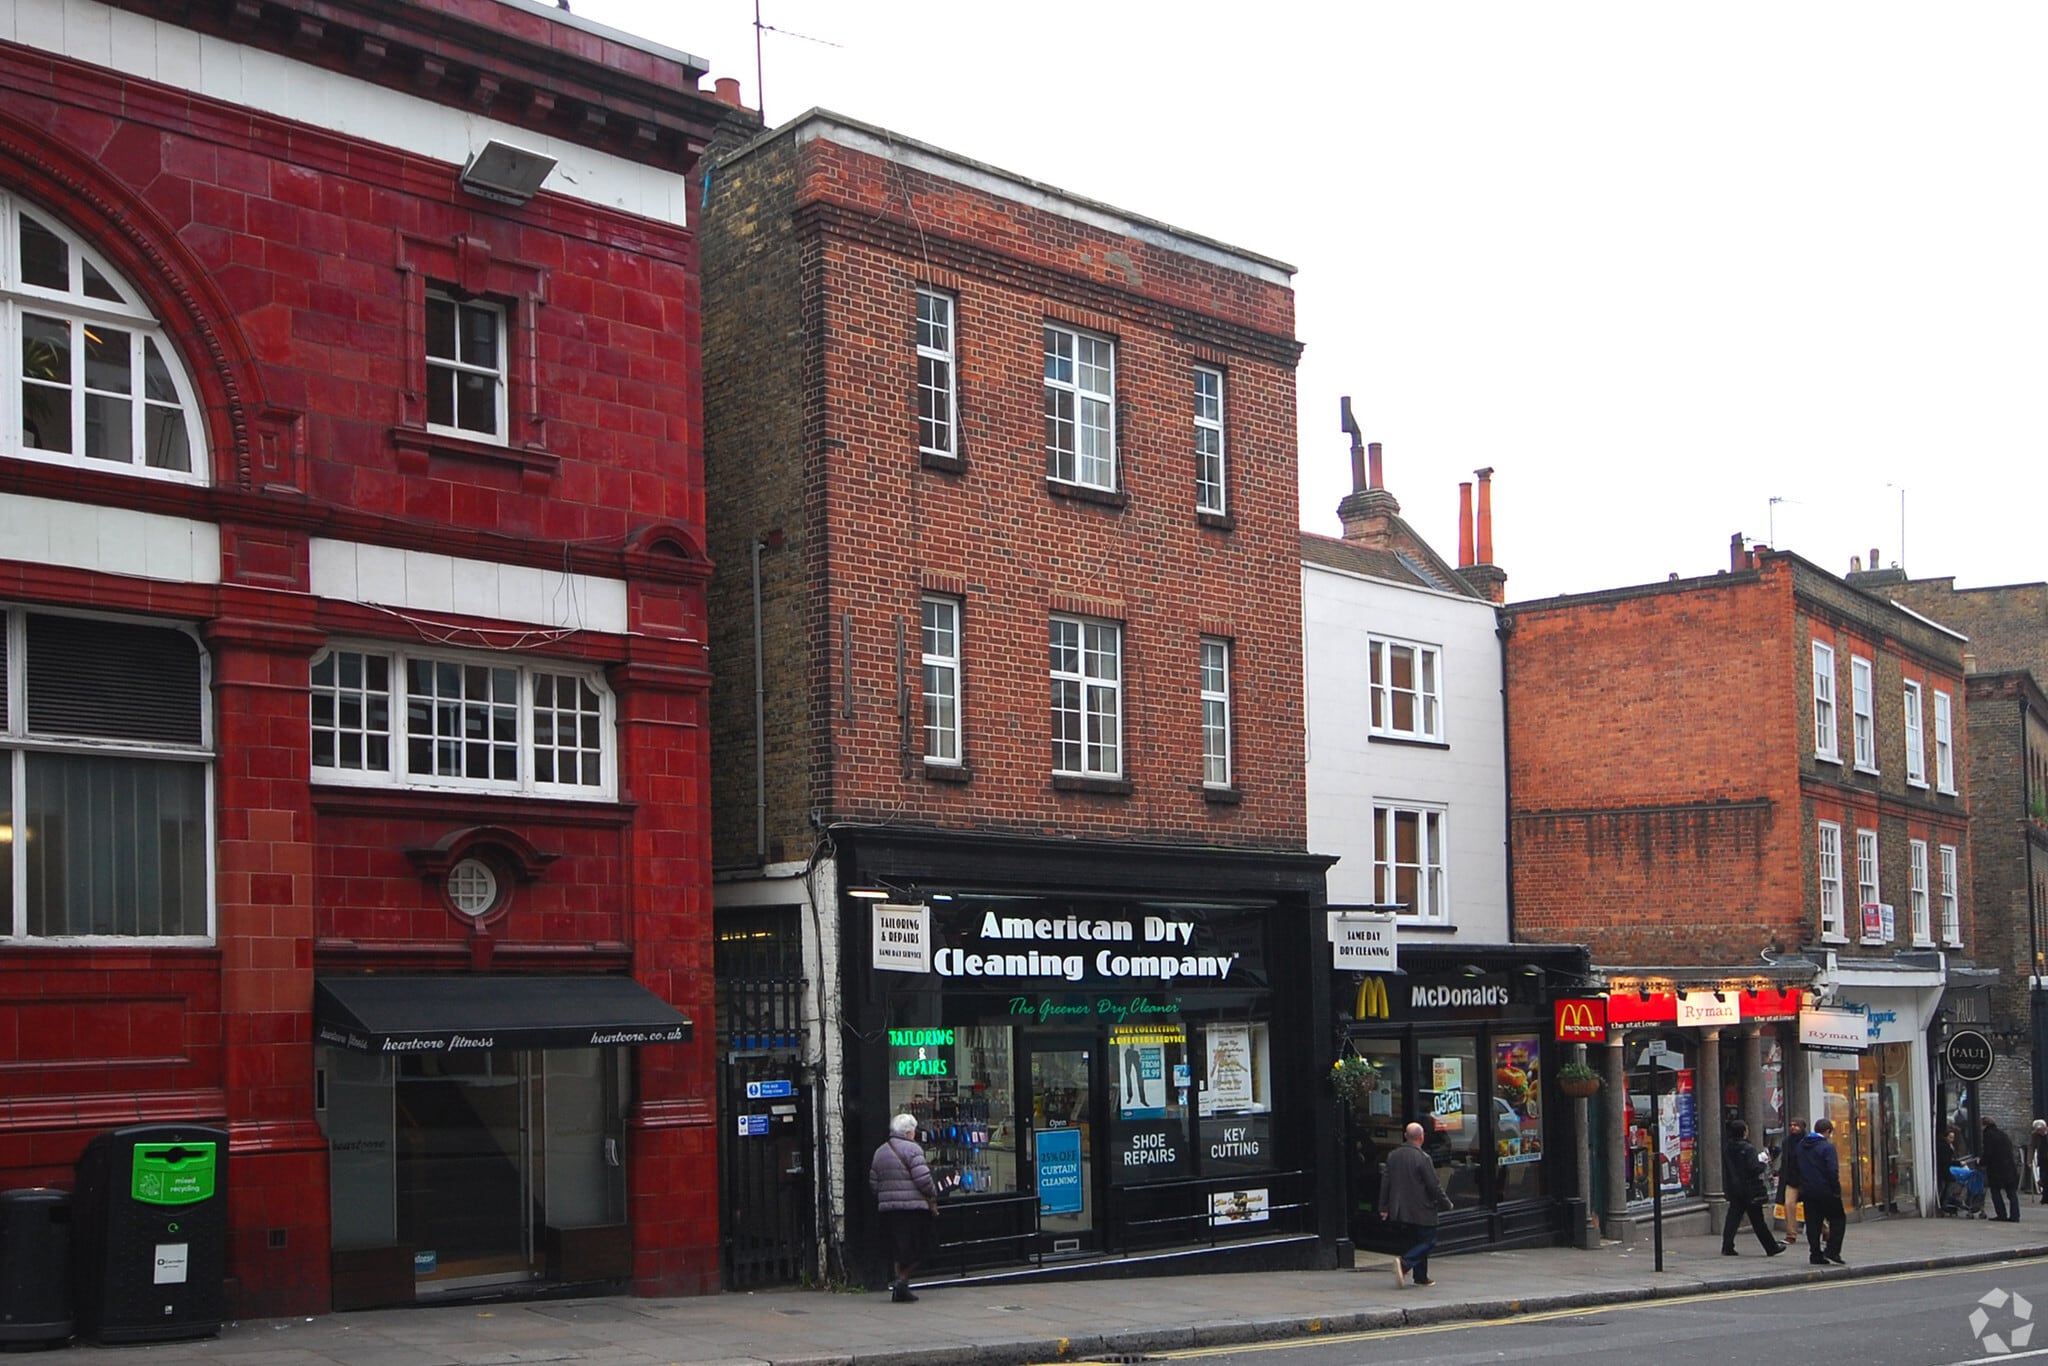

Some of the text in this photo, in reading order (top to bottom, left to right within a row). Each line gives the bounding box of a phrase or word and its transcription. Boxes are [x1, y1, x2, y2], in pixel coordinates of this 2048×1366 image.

[880, 917, 920, 930] TAILORING
[980, 911, 1194, 945] American Dry
[881, 931, 919, 944] & REPAIRS
[1347, 931, 1380, 941] SAME DAY
[1340, 946, 1390, 957] DRY CLEANING
[934, 947, 1084, 981] Cleaning
[1411, 985, 1509, 1007] McDonald's
[1008, 997, 1035, 1015] The
[1039, 998, 1090, 1023] Greener
[1097, 998, 1128, 1024] Dry
[1685, 1005, 1733, 1020] Ryman
[1956, 998, 1977, 1022] PAUL
[1134, 1024, 1181, 1034] COLLECTION
[1611, 1020, 1625, 1029] the
[590, 1027, 682, 1044] heartcore.co.uk
[888, 1029, 954, 1046] TAILORING
[1808, 1030, 1859, 1040] Ryman
[382, 1035, 494, 1051] heartcore fitness
[918, 1047, 927, 1060] &
[1952, 1047, 1986, 1058] PAUL
[897, 1060, 947, 1076] REPAIRS
[1141, 1060, 1160, 1068] FROM
[1049, 1119, 1067, 1129] Open
[1132, 1133, 1166, 1149] SHOE
[1224, 1127, 1246, 1142] KEY
[1124, 1148, 1176, 1166] REPAIRS
[1211, 1141, 1259, 1159] CUTTING
[1041, 1163, 1077, 1175] CURTAIN
[1041, 1176, 1078, 1187] CLEANING
[170, 1185, 200, 1193] recycling
